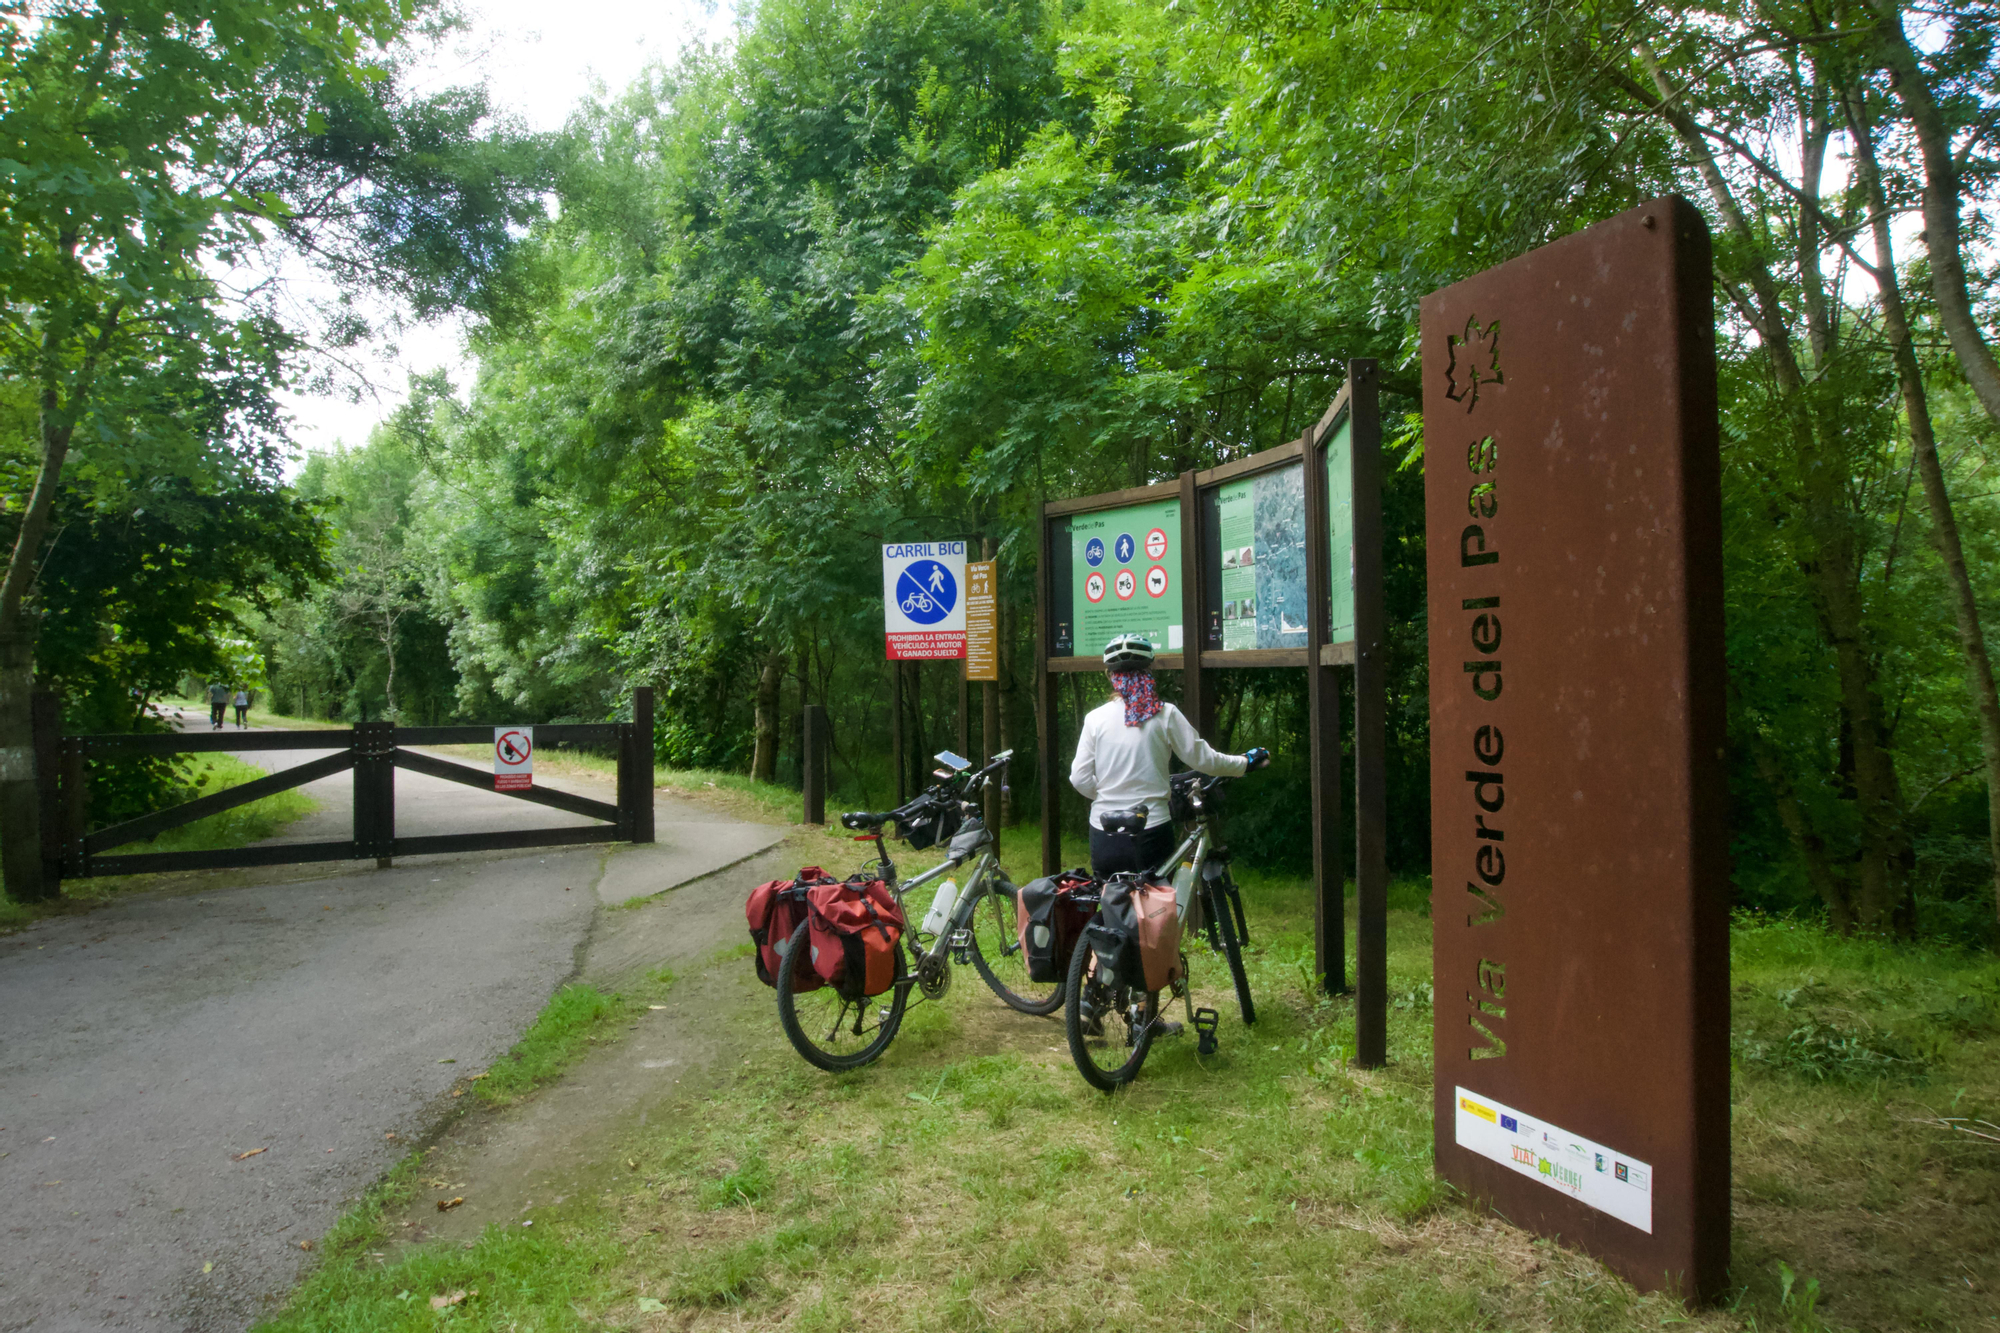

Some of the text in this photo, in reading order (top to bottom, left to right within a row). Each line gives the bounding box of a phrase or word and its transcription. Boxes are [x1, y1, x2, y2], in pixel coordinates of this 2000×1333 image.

[1460, 435, 1499, 568] Pas
[886, 541, 964, 559] CARRIL BICI
[888, 632, 967, 642] PROHIBIDA LA ENTRADA
[893, 640, 963, 650] VEHÍCULOS A MOTOR
[897, 648, 958, 658] Y GANADO SUELTO
[1462, 595, 1503, 702] del
[1465, 724, 1506, 928] Verde
